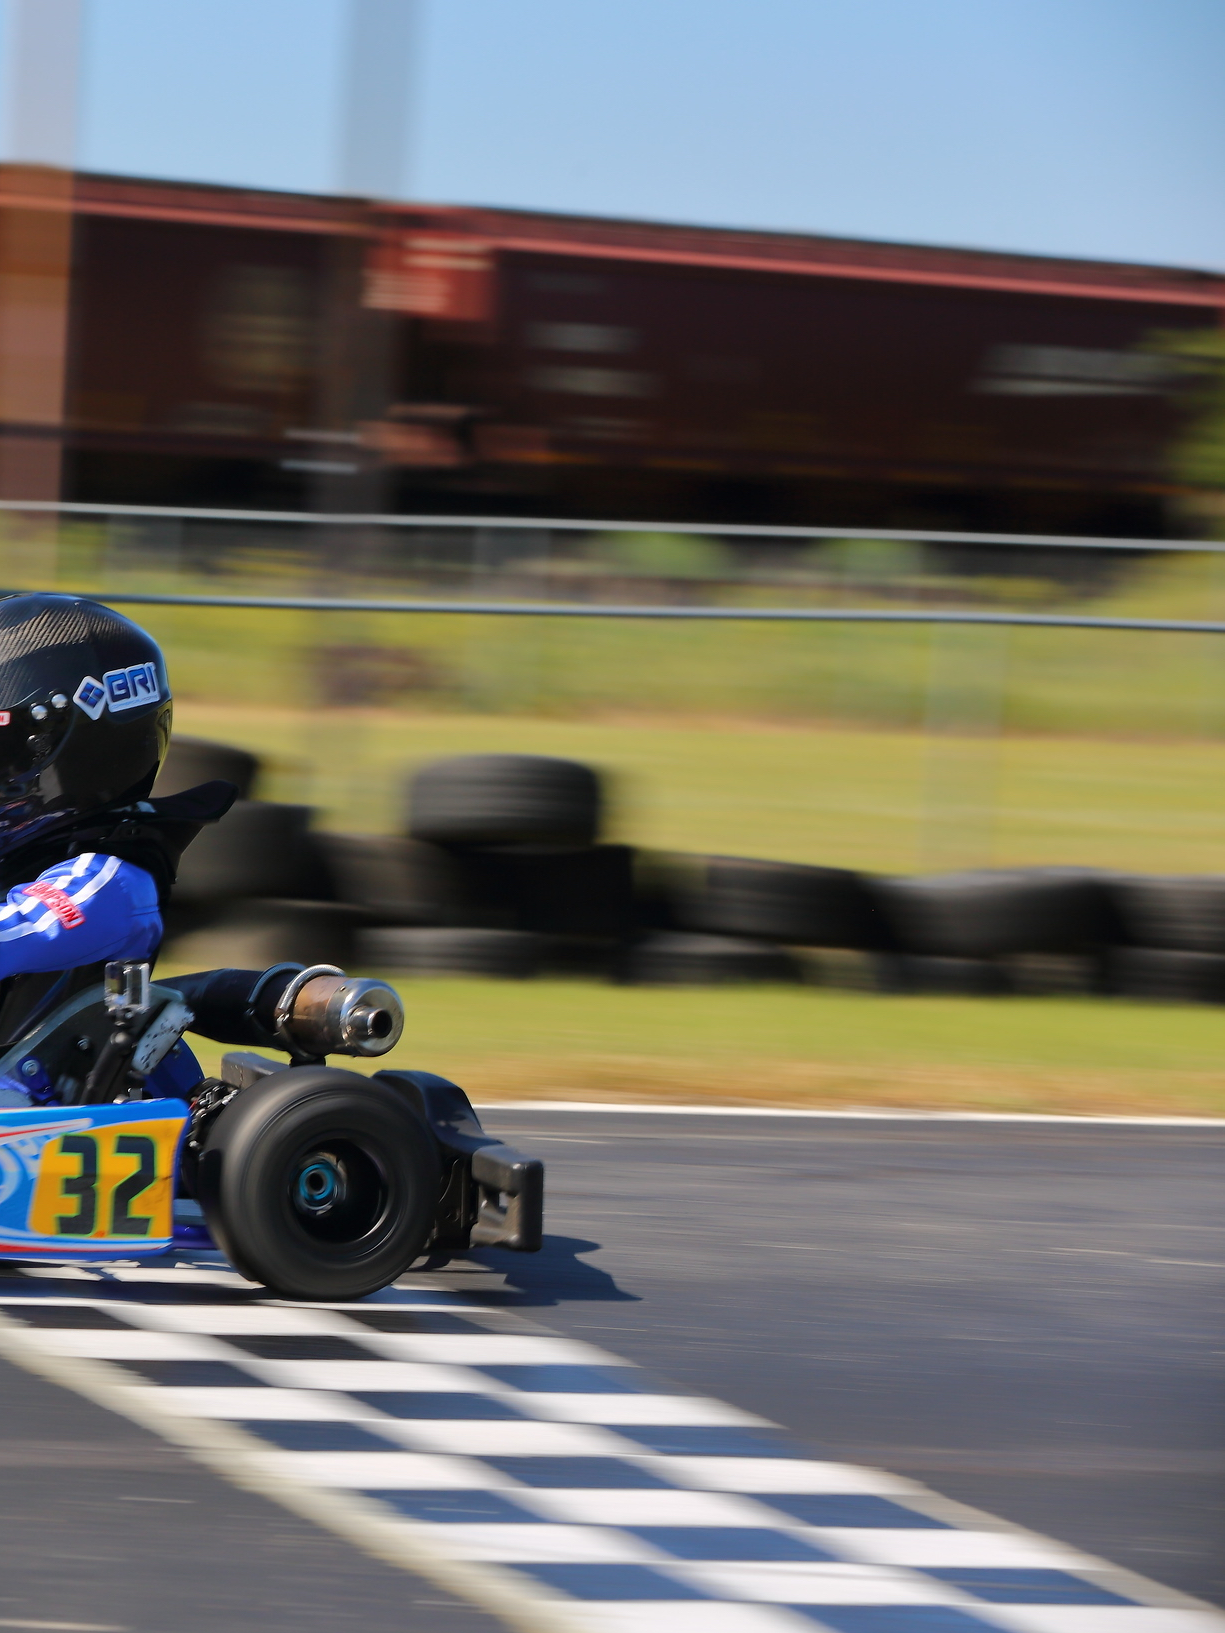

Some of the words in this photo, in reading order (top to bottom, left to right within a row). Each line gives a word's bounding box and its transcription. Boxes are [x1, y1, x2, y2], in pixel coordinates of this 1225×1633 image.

[106, 666, 157, 703] BRI
[29, 883, 83, 923] SIMPSON
[55, 1133, 157, 1237] 32
